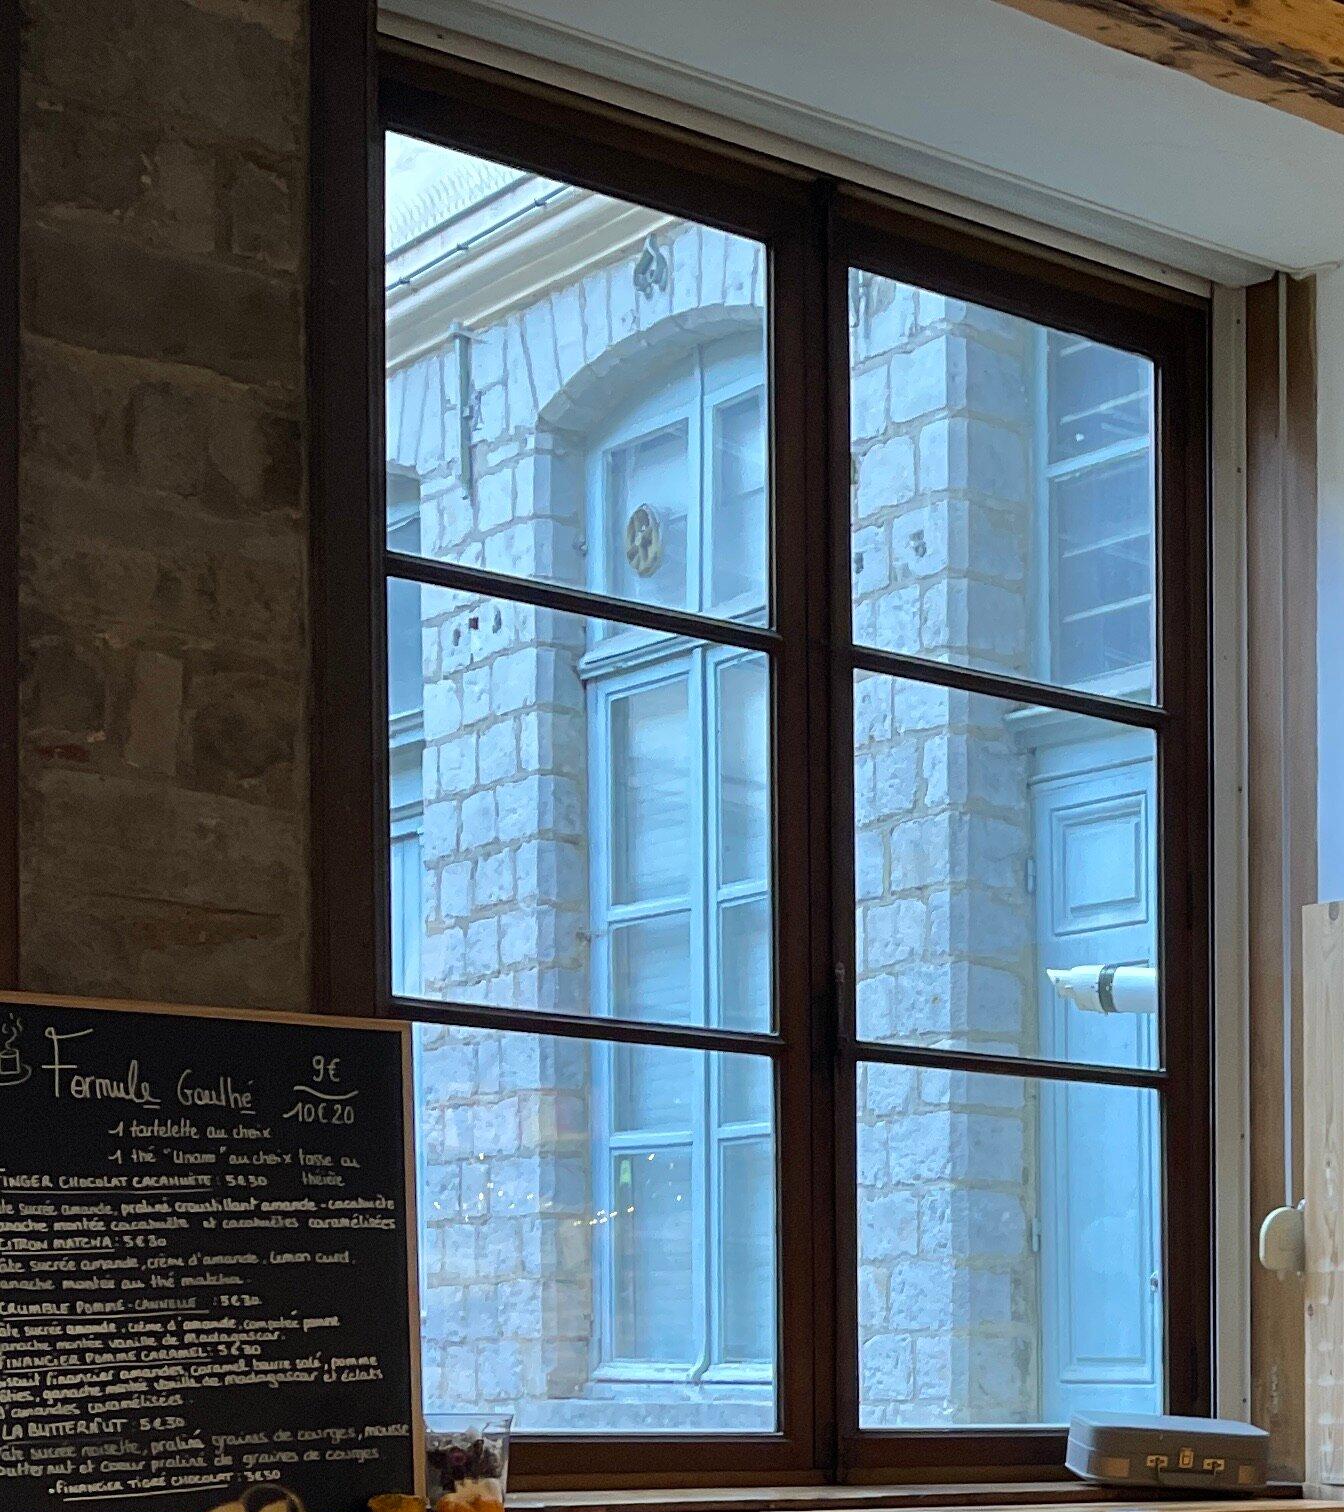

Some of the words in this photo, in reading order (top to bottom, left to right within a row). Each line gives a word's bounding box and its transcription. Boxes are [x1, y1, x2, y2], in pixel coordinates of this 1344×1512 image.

[42, 1027, 161, 1103] Formule
[312, 1055, 340, 1082] 9€
[108, 1121, 123, 1136] 1
[130, 1118, 199, 1138] tartelette
[207, 1127, 227, 1138] au
[233, 1124, 271, 1138] choix
[108, 1149, 122, 1164] 1
[131, 1146, 156, 1162] thé
[253, 1151, 292, 1164] choix
[299, 1149, 334, 1166] tasse
[59, 1176, 128, 1188] CHOCOLAT
[0, 1219, 49, 1231] anache
[203, 1217, 216, 1228] et
[0, 1257, 25, 1273] âte
[29, 1257, 76, 1271] sucrée
[270, 1251, 311, 1264] lemon
[0, 1278, 55, 1290] anache
[121, 1280, 145, 1289] au
[150, 1271, 175, 1288] thé
[0, 1322, 20, 1337] âte
[0, 1340, 53, 1350] anache
[2, 1424, 23, 1440] LA
[28, 1417, 128, 1437] BUTTERNUT
[0, 1446, 25, 1461] âte
[273, 1428, 293, 1441] de
[79, 1459, 95, 1474] et
[214, 1454, 233, 1466] de
[303, 1450, 320, 1461] de
